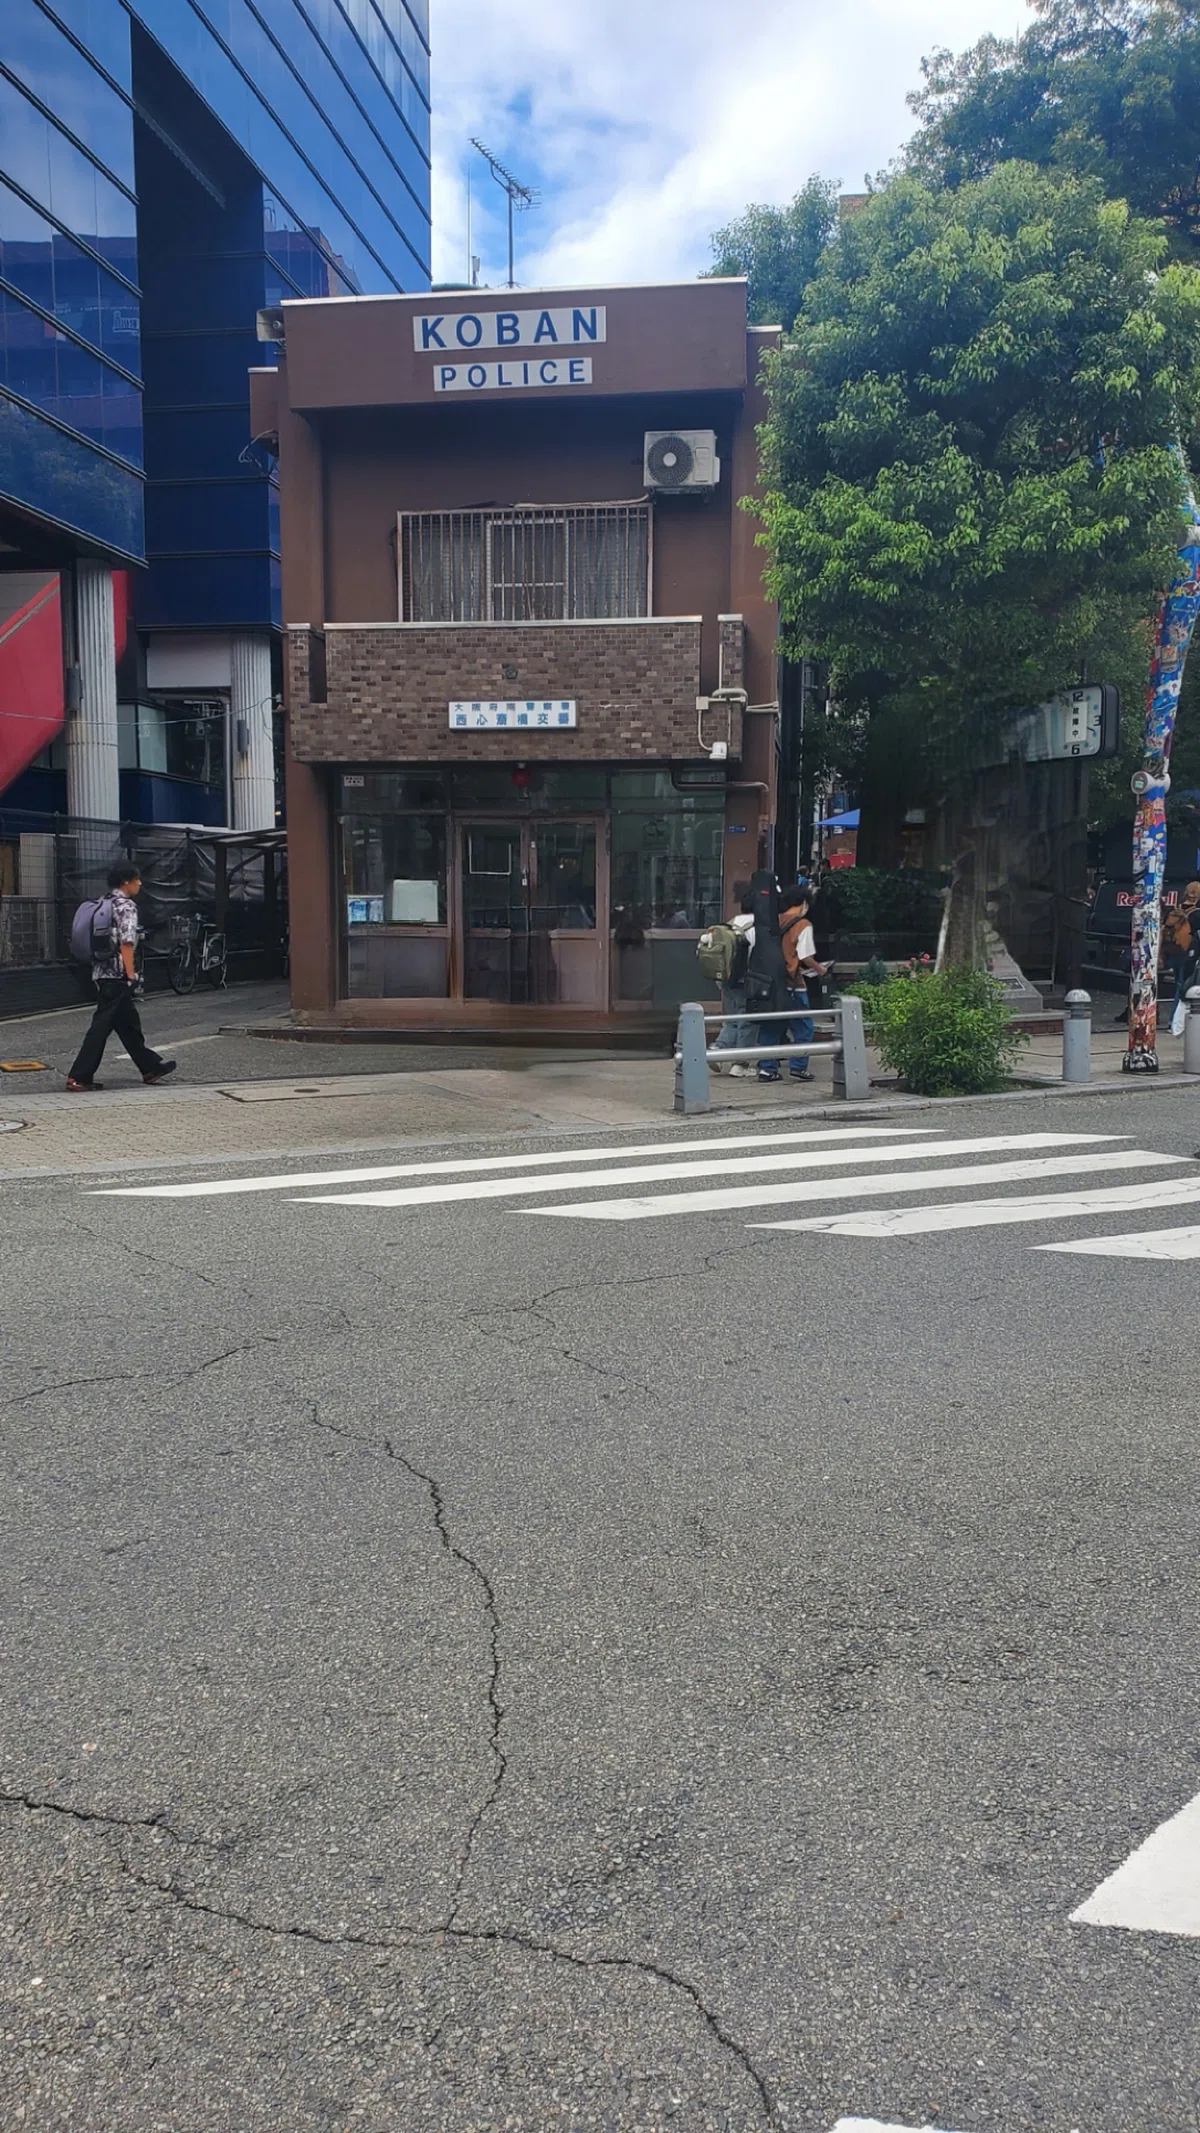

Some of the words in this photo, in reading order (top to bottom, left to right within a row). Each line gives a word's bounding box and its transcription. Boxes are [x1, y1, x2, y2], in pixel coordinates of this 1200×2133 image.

[421, 308, 598, 349] KOBAN
[441, 359, 585, 389] POLICE
[1072, 691, 1083, 702] 12
[1093, 715, 1101, 727] 3
[1071, 744, 1080, 754] 6
